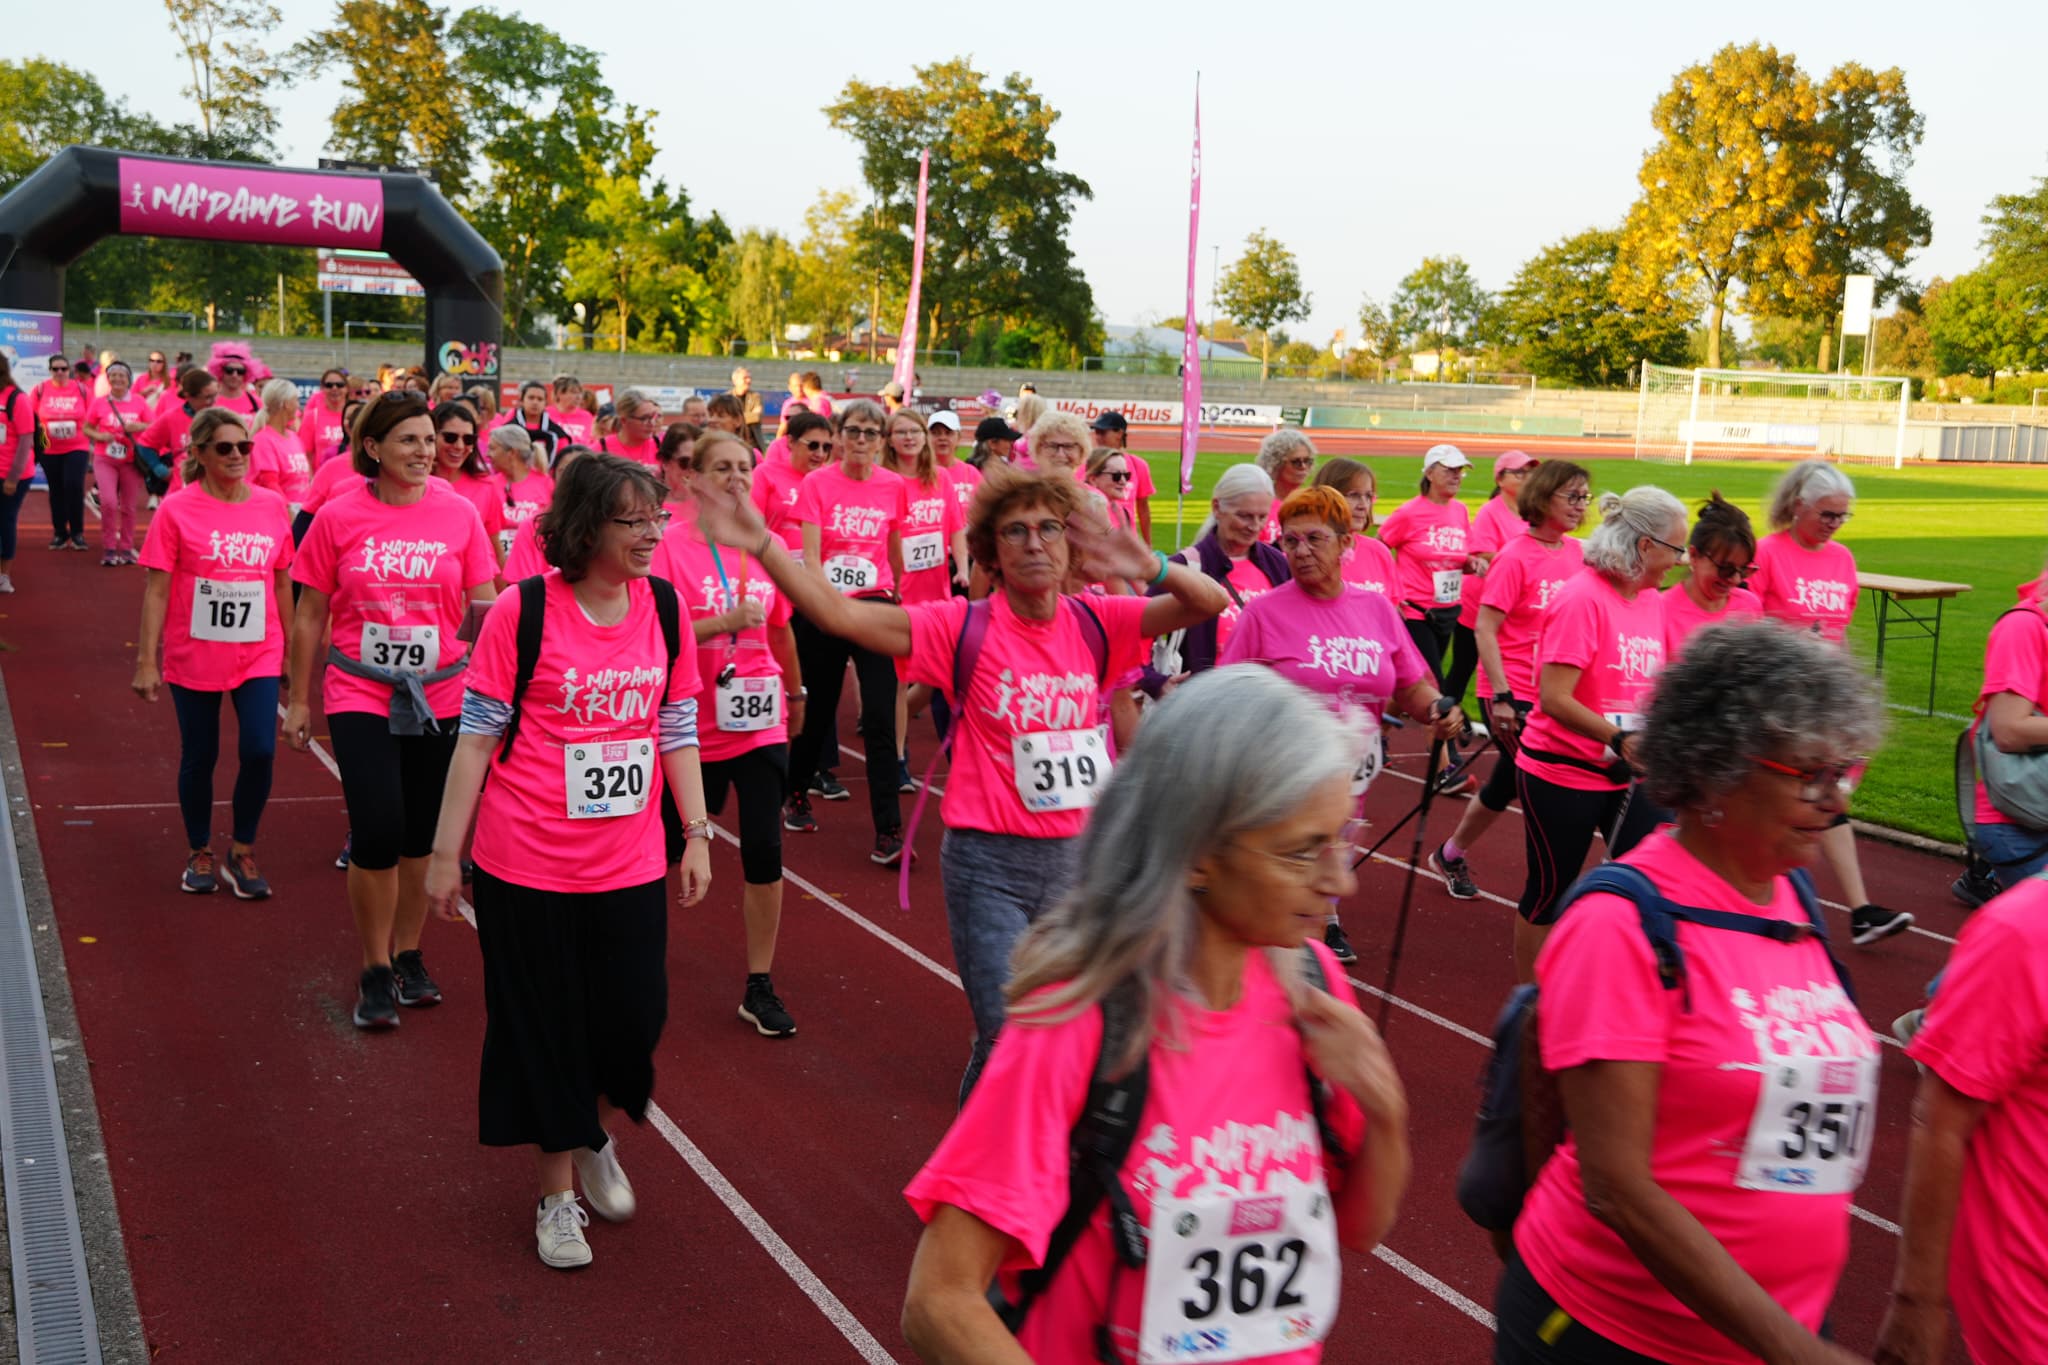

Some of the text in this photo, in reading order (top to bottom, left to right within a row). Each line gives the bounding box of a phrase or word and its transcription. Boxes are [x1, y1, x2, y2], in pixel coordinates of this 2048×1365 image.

[308, 193, 379, 233] RUN
[844, 516, 880, 536] RUN
[226, 543, 270, 566] RUN
[913, 544, 936, 560] 277
[379, 554, 437, 579] RUN
[831, 567, 866, 587] 368
[216, 588, 260, 598] Sparkasse
[208, 600, 251, 628] 167
[373, 642, 425, 666] 379
[1326, 650, 1380, 676] RUN
[583, 686, 655, 722] RUN
[731, 695, 773, 718] 384
[1017, 692, 1088, 730] RUN
[584, 763, 643, 799] 320
[1032, 755, 1097, 792] 319
[1182, 1238, 1308, 1320] 362
